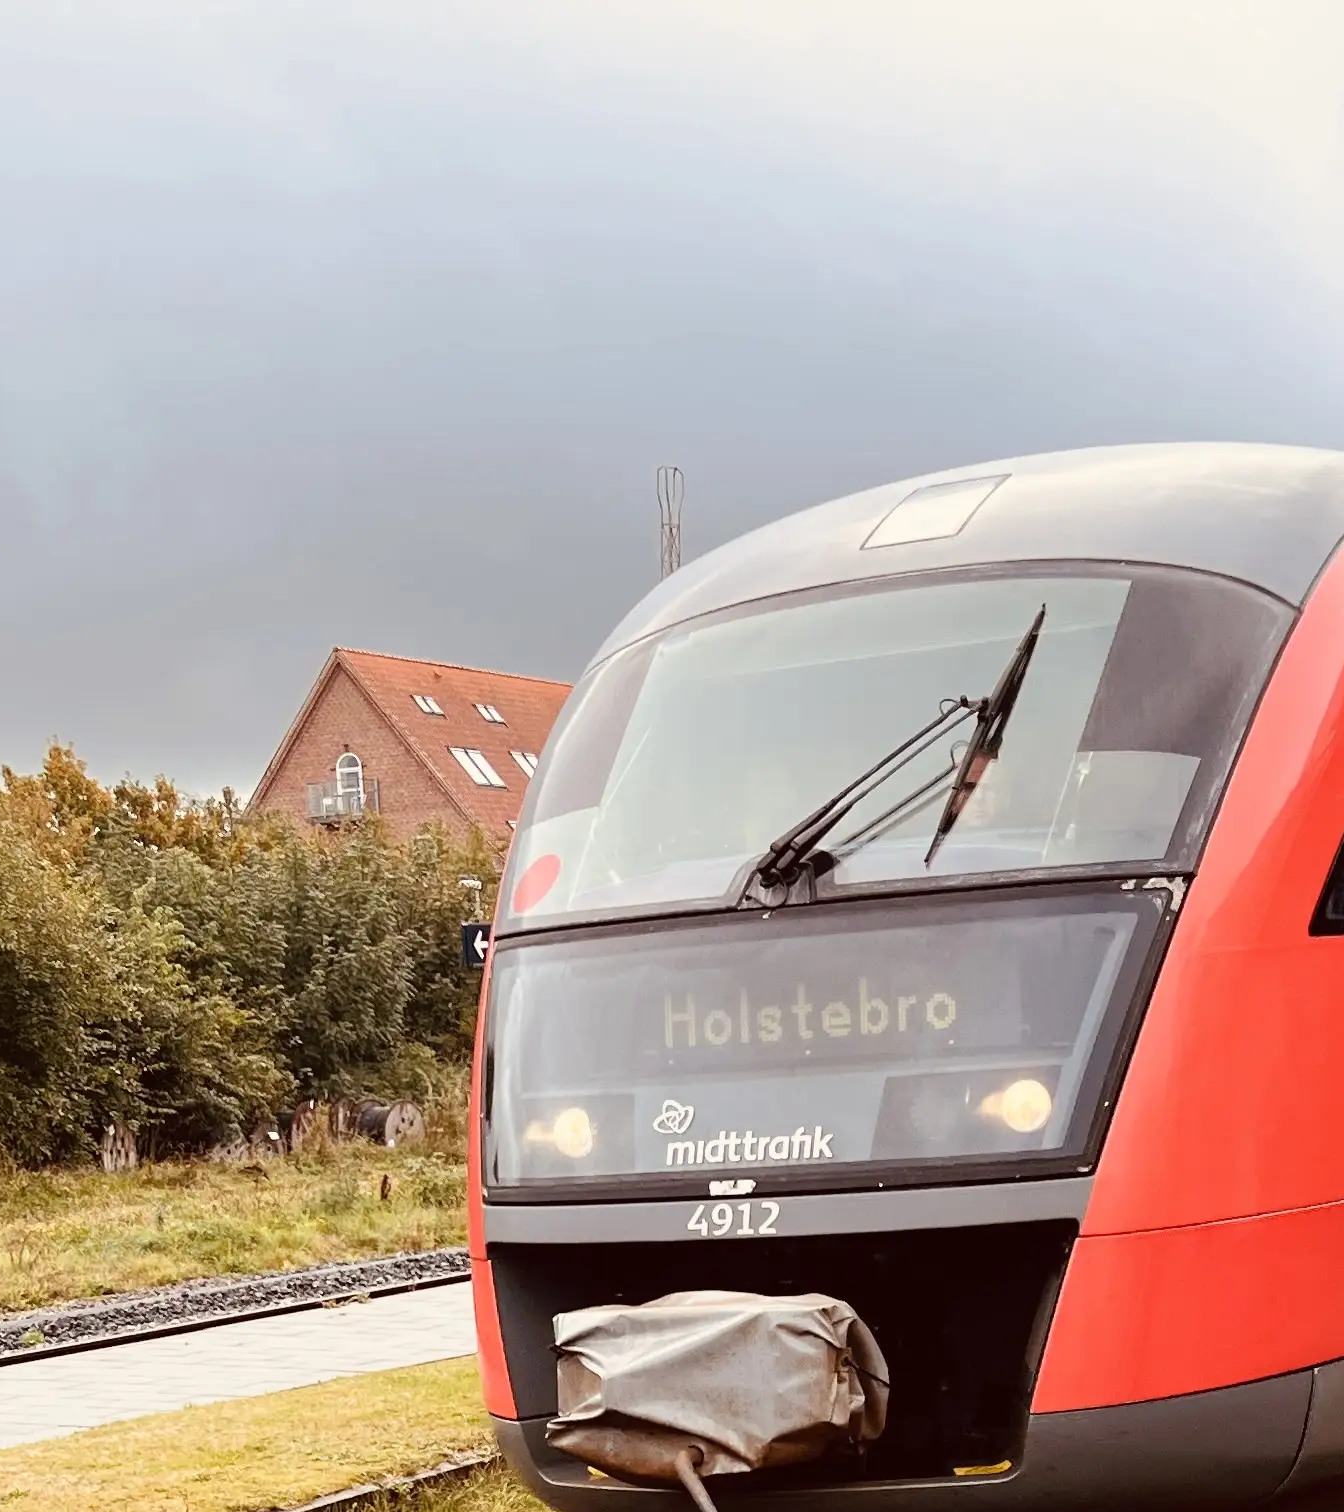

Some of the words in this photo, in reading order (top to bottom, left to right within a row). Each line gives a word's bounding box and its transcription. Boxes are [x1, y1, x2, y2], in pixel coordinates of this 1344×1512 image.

[664, 977, 957, 1049] Holstebro
[665, 1125, 834, 1166] midttrafik
[687, 1201, 780, 1237] 4912
